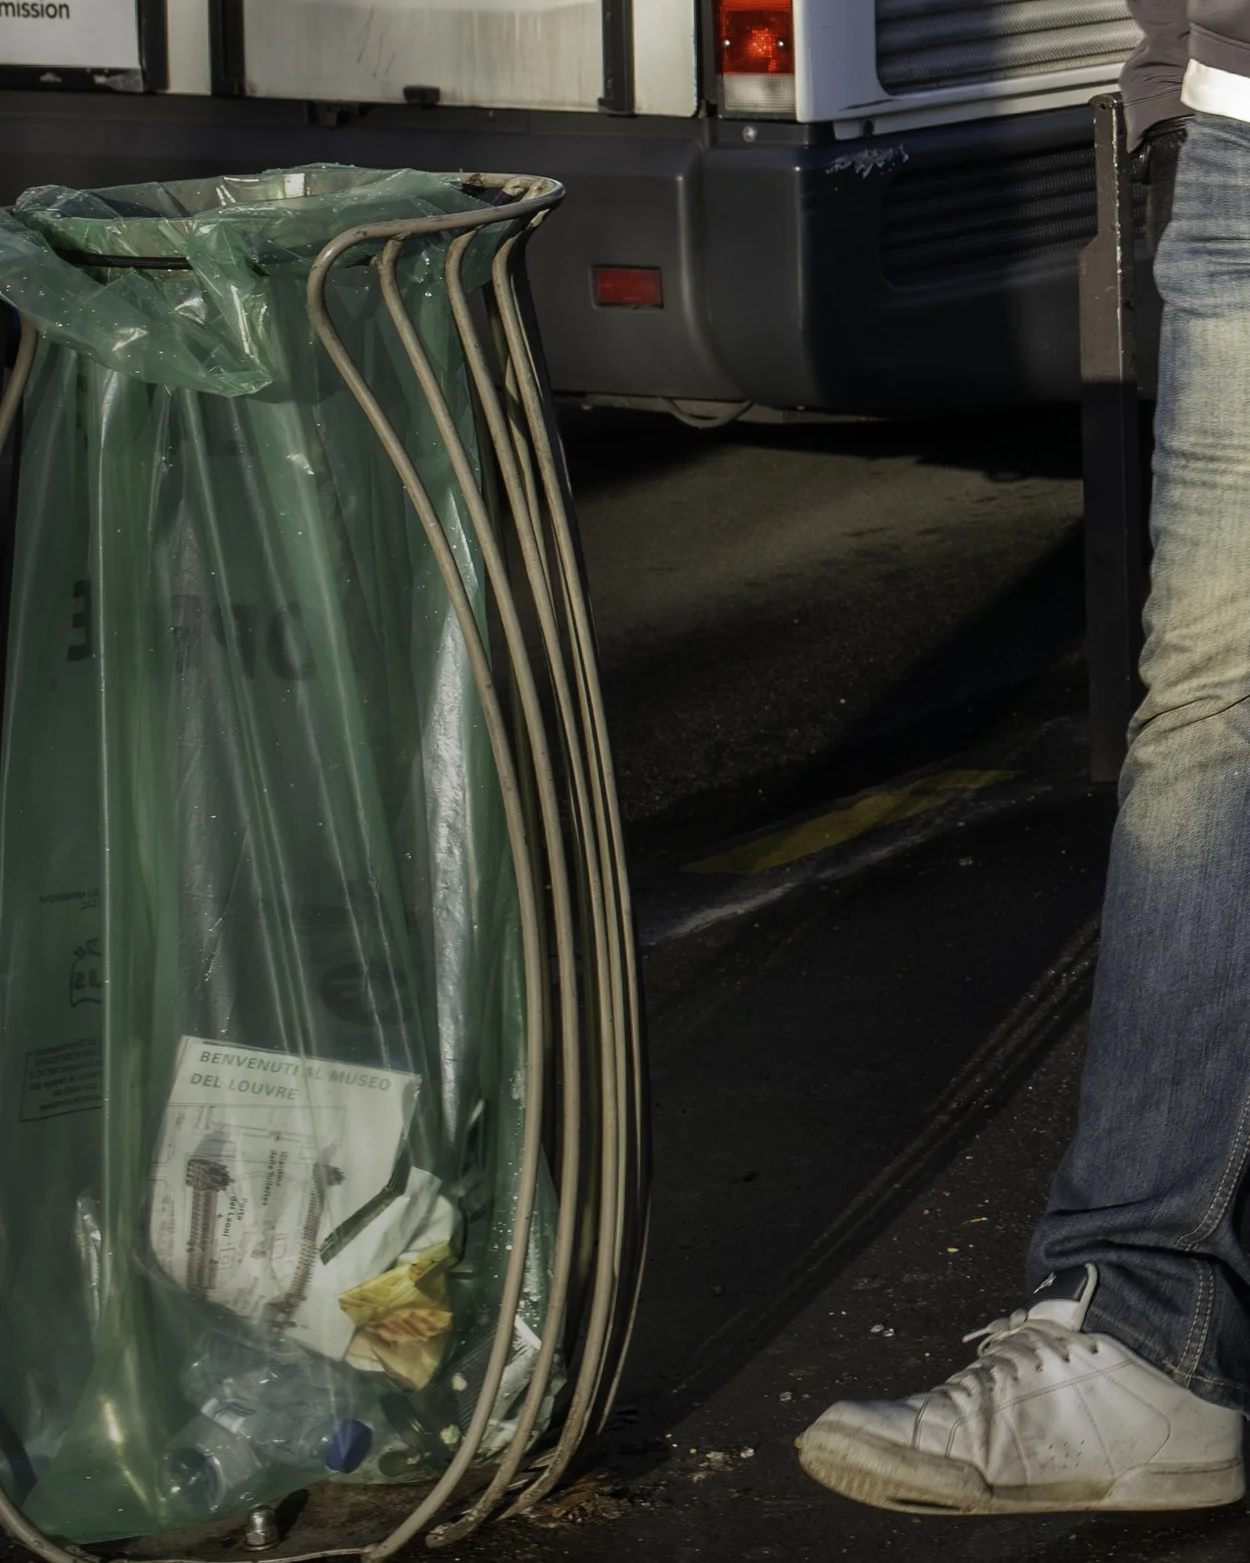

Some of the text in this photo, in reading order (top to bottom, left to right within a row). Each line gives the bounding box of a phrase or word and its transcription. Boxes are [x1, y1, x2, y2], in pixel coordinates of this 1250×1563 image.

[190, 1073, 299, 1101] DEL LOUVRE
[200, 1050, 299, 1076] BENVENUTI
[328, 1069, 392, 1091] MUSEO
